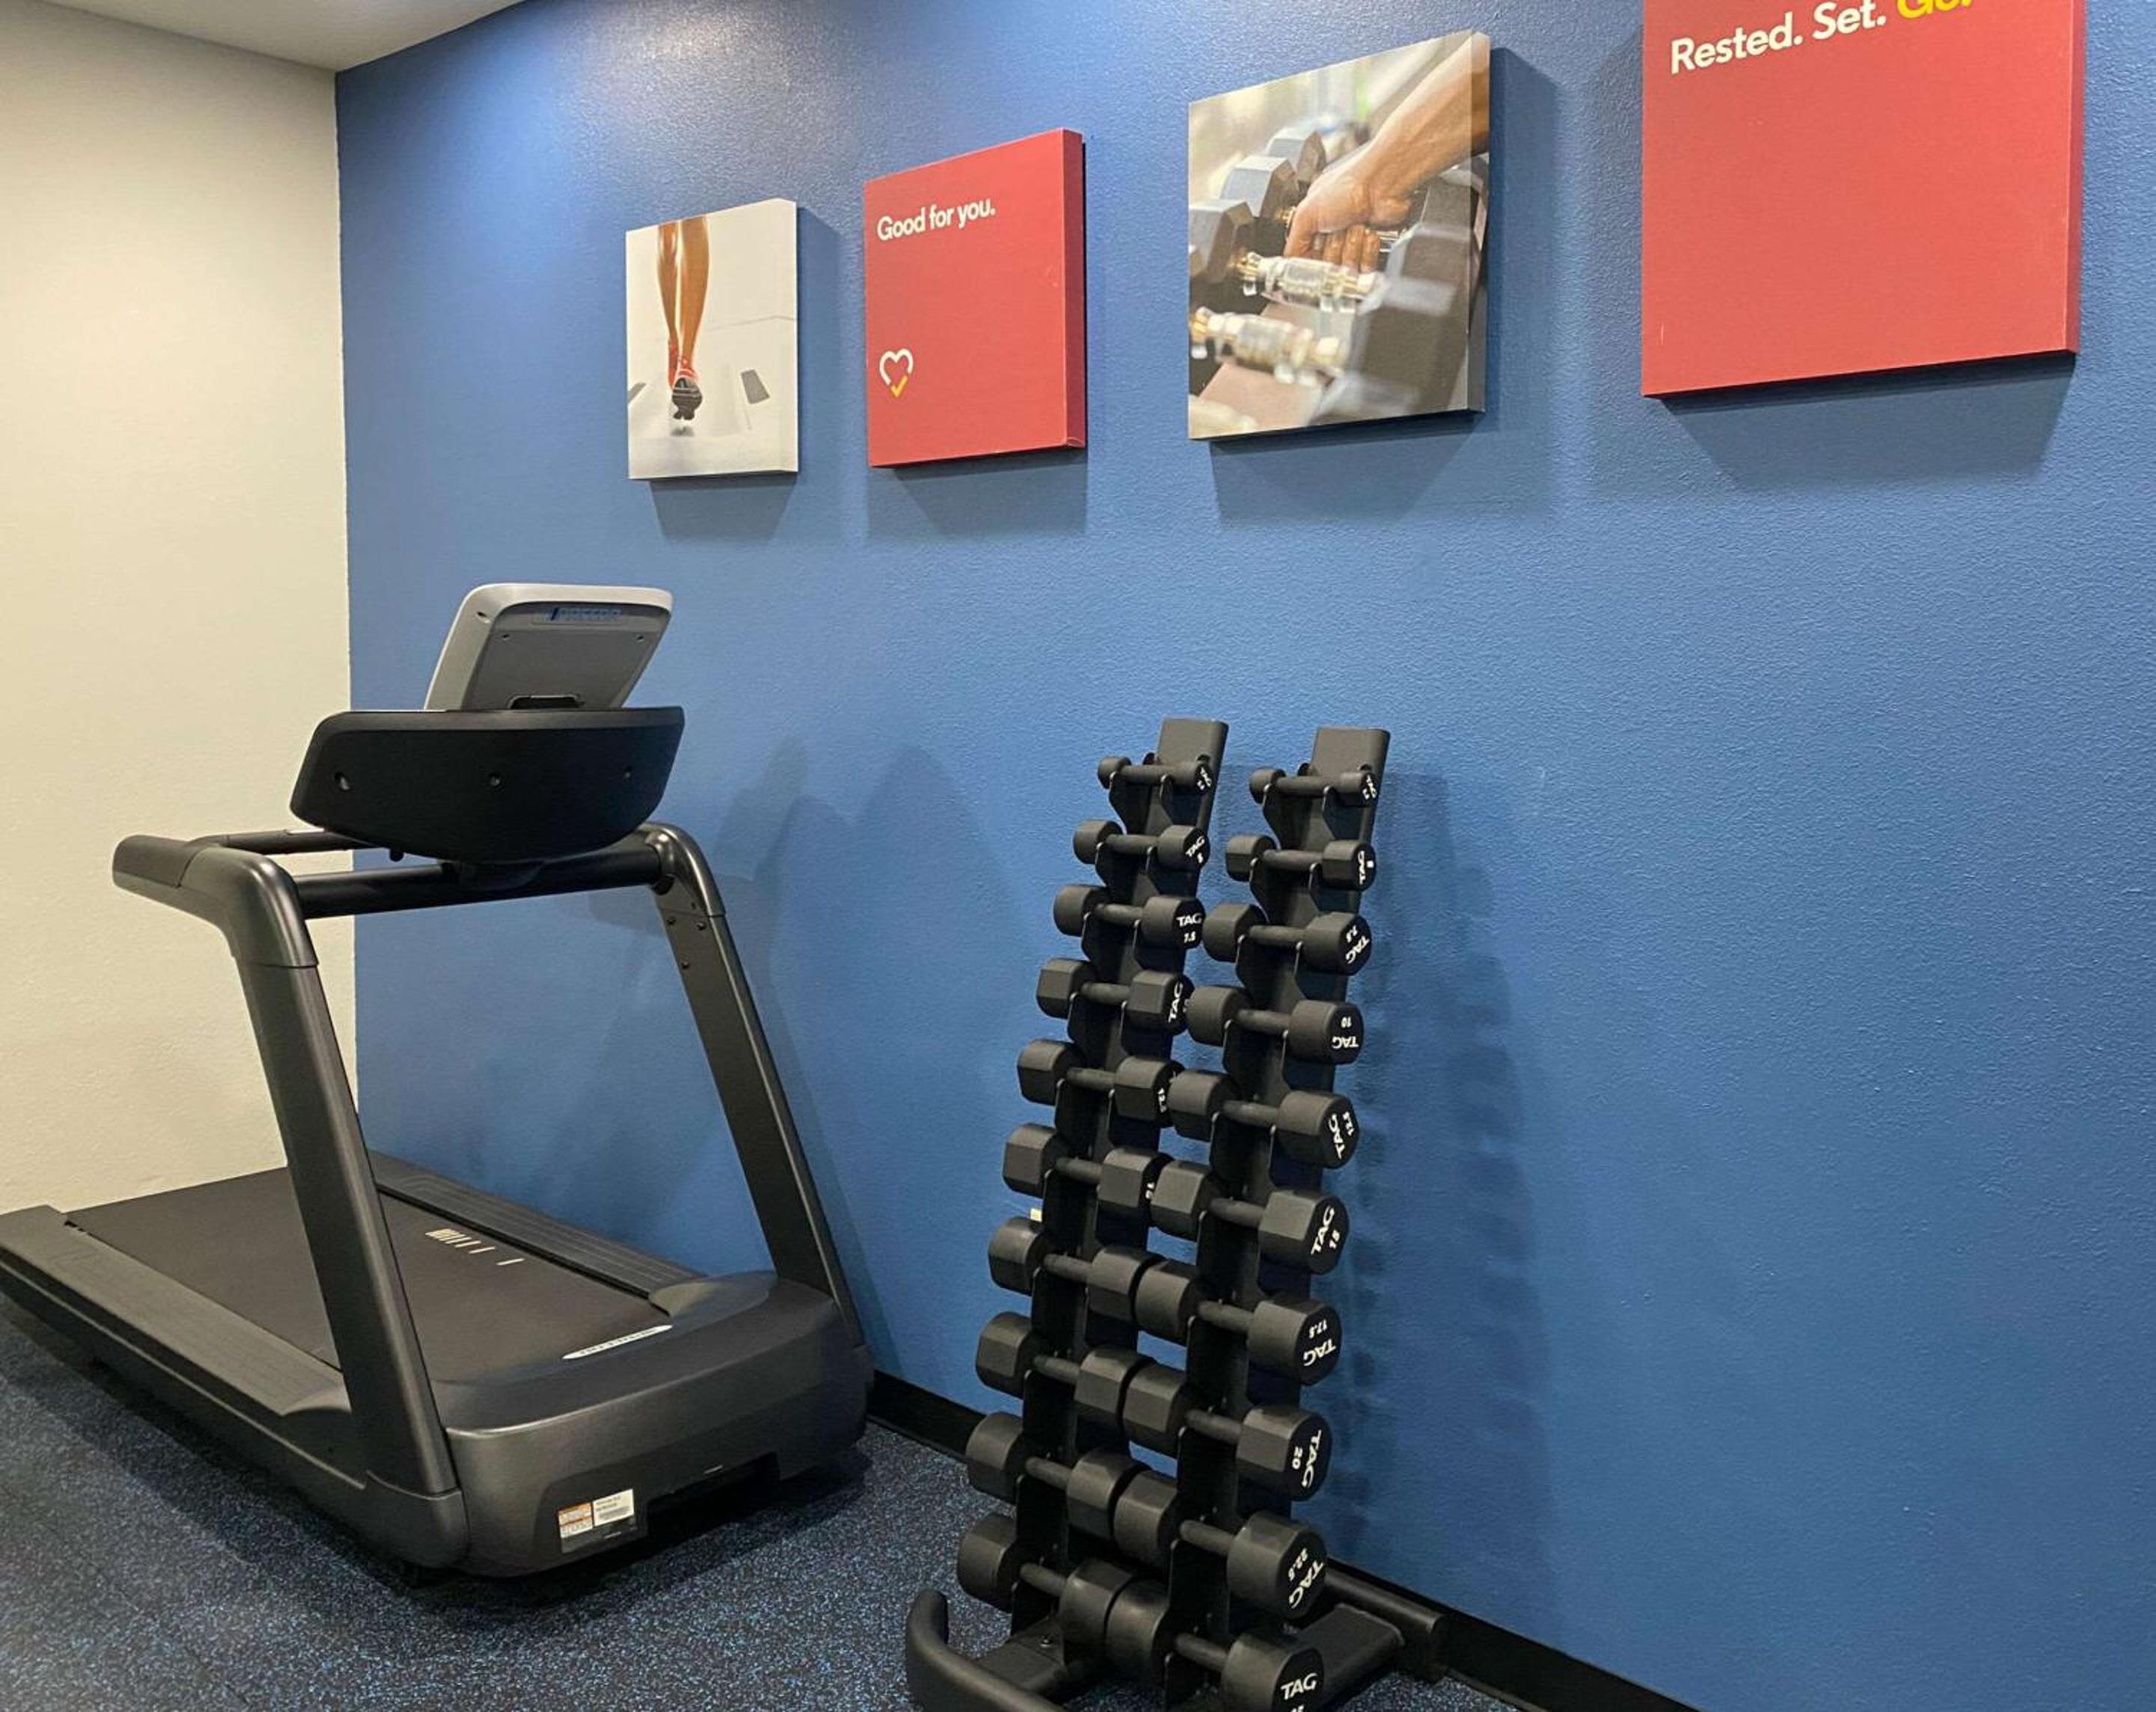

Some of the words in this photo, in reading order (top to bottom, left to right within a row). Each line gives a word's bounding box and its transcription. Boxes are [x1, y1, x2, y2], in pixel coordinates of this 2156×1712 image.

[1670, 11, 1803, 75] Rested.
[1812, 1, 1886, 41] Set.
[877, 207, 926, 241] Good
[929, 204, 954, 231] for
[957, 198, 996, 229] you.
[1185, 835, 1205, 857] TAG
[1176, 913, 1202, 927] TAG
[1345, 935, 1370, 964] TAG
[1168, 981, 1184, 1023] TAG
[1331, 1035, 1359, 1050] TAG
[1328, 1112, 1345, 1160] TAG
[1310, 1204, 1335, 1255] TAG
[1303, 1338, 1336, 1367] TAG
[1291, 1446, 1303, 1470] 20
[1302, 1429, 1322, 1489] TAG
[1288, 1560, 1324, 1609] TAG
[1280, 1672, 1318, 1700] TAG
